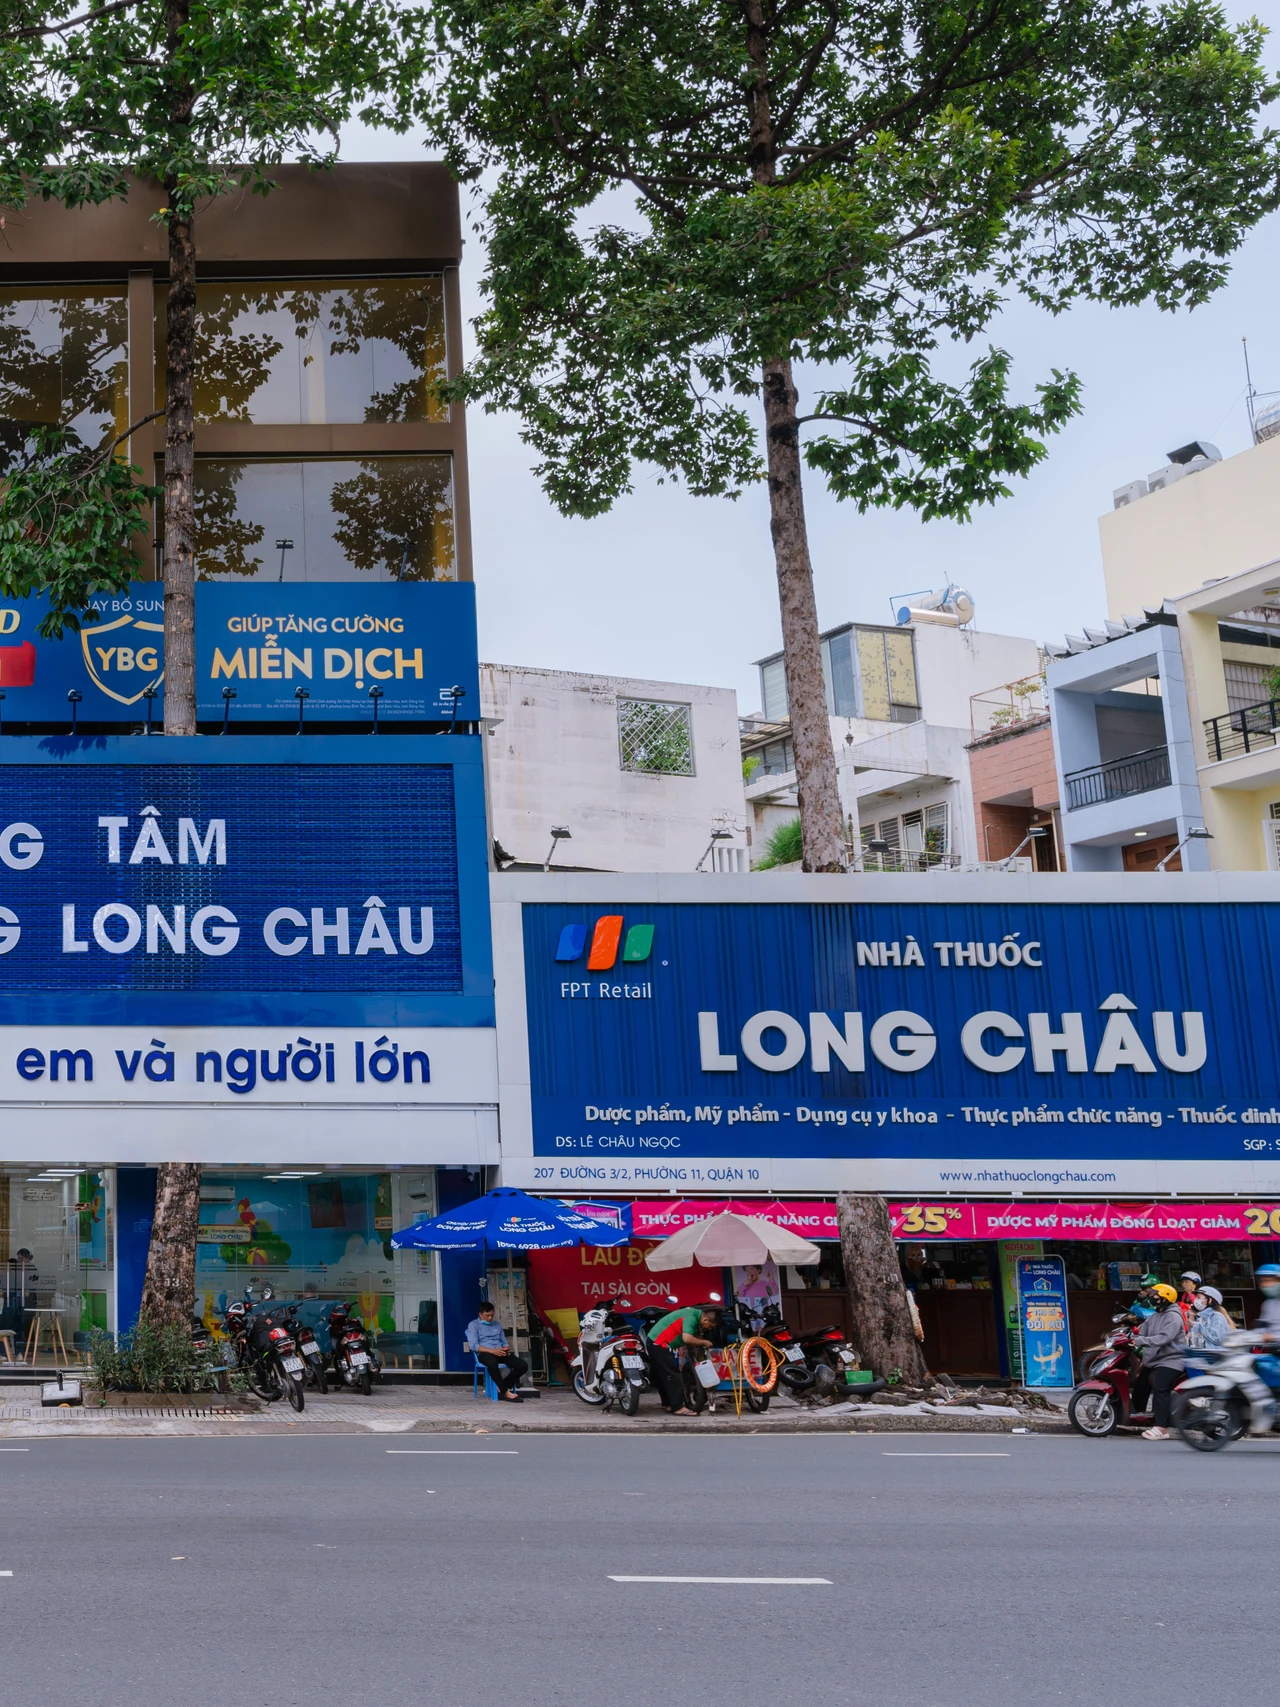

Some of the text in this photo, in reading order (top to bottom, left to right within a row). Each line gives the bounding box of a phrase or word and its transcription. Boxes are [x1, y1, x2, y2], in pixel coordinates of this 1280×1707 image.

[136, 601, 164, 612] SUN
[227, 612, 404, 634] GIÚP TĂNG CƯỜNG
[95, 647, 158, 672] YBG
[210, 634, 423, 690] MIỄN DỊCH
[97, 805, 228, 866] TÂM
[61, 903, 240, 957] LONG
[263, 895, 435, 957] CHÂU
[857, 932, 1043, 967] NHÀ THUỐC
[561, 982, 652, 999] FPT Retail
[698, 993, 1208, 1073] LONG CHÂU
[16, 1047, 94, 1082] em
[114, 1038, 175, 1082] và
[195, 1036, 336, 1094] người
[354, 1034, 431, 1083] lớn
[585, 1105, 632, 1126] Dược
[635, 1102, 692, 1126] phẩm,
[694, 1105, 723, 1126] Mỹ
[727, 1102, 780, 1126] phẩm
[796, 1106, 848, 1126] Dụng
[851, 1109, 872, 1127] cụ
[876, 1110, 888, 1127] y
[891, 1106, 939, 1124] khoa
[960, 1106, 1009, 1127] Thực
[1011, 1103, 1065, 1127] phẩm
[1114, 1107, 1163, 1128] năng
[1177, 1104, 1237, 1124] Thuốc
[555, 1134, 681, 1150] DS: LÊ CHÂU NGỌC
[533, 1164, 759, 1182] 207 ĐƯỜNG 3/2, PHƯỜNG 11, QUẬN 10
[940, 1169, 1116, 1185] www.nhathuoclongchau.com
[528, 1224, 555, 1233] CHÂU
[639, 1214, 681, 1227] THỰC
[684, 1210, 717, 1224] PHẨ
[777, 1212, 820, 1226] NĂNG
[901, 1206, 962, 1233] 35%
[987, 1214, 1032, 1230] DƯỢC
[1035, 1213, 1059, 1228] MỸ
[1061, 1213, 1107, 1228] PHẨM
[1109, 1214, 1155, 1229] ĐỒNG
[1158, 1218, 1197, 1231] LOẠT
[1200, 1214, 1240, 1229] GIẢM
[518, 1242, 540, 1250] 6928
[581, 1278, 671, 1299] TẠI SÀI GÒN
[1026, 1316, 1065, 1329] ĐỔI MỚI
